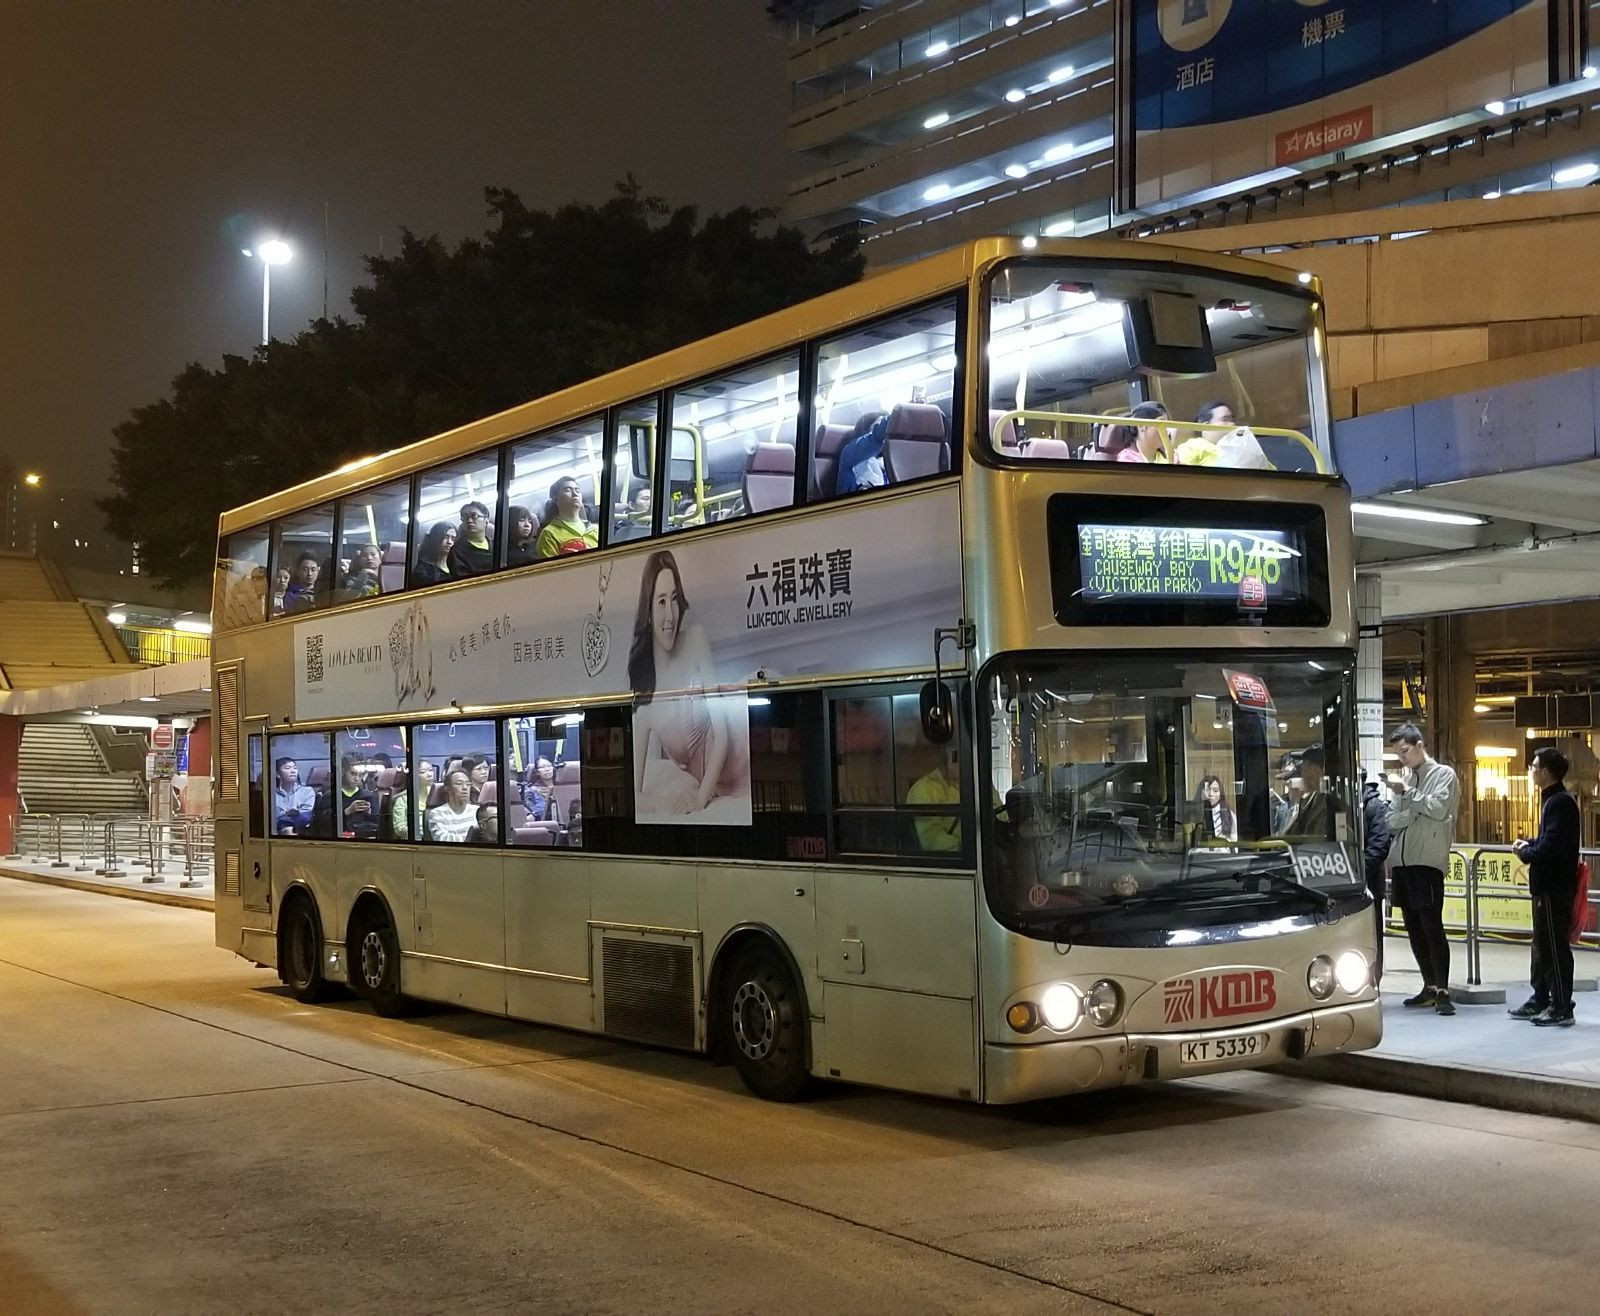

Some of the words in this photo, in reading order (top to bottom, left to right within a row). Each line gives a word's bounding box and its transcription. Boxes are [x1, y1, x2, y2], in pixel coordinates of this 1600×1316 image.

[1301, 9, 1346, 48] 機票
[1176, 57, 1215, 92] 酒店
[1304, 118, 1363, 150] Asiaray
[745, 549, 852, 609] 六福珠寶
[1095, 559, 1162, 576] CAUSEWAY
[1170, 561, 1195, 577] BAY
[1089, 576, 1160, 593] (VICTORIA
[1164, 577, 1203, 594] PARK)
[746, 607, 791, 629] LUKFOOK
[793, 600, 853, 623] JEWELLERY
[1298, 853, 1347, 878] R948
[1187, 1042, 1208, 1061] KT
[1216, 1036, 1257, 1058] 5339
